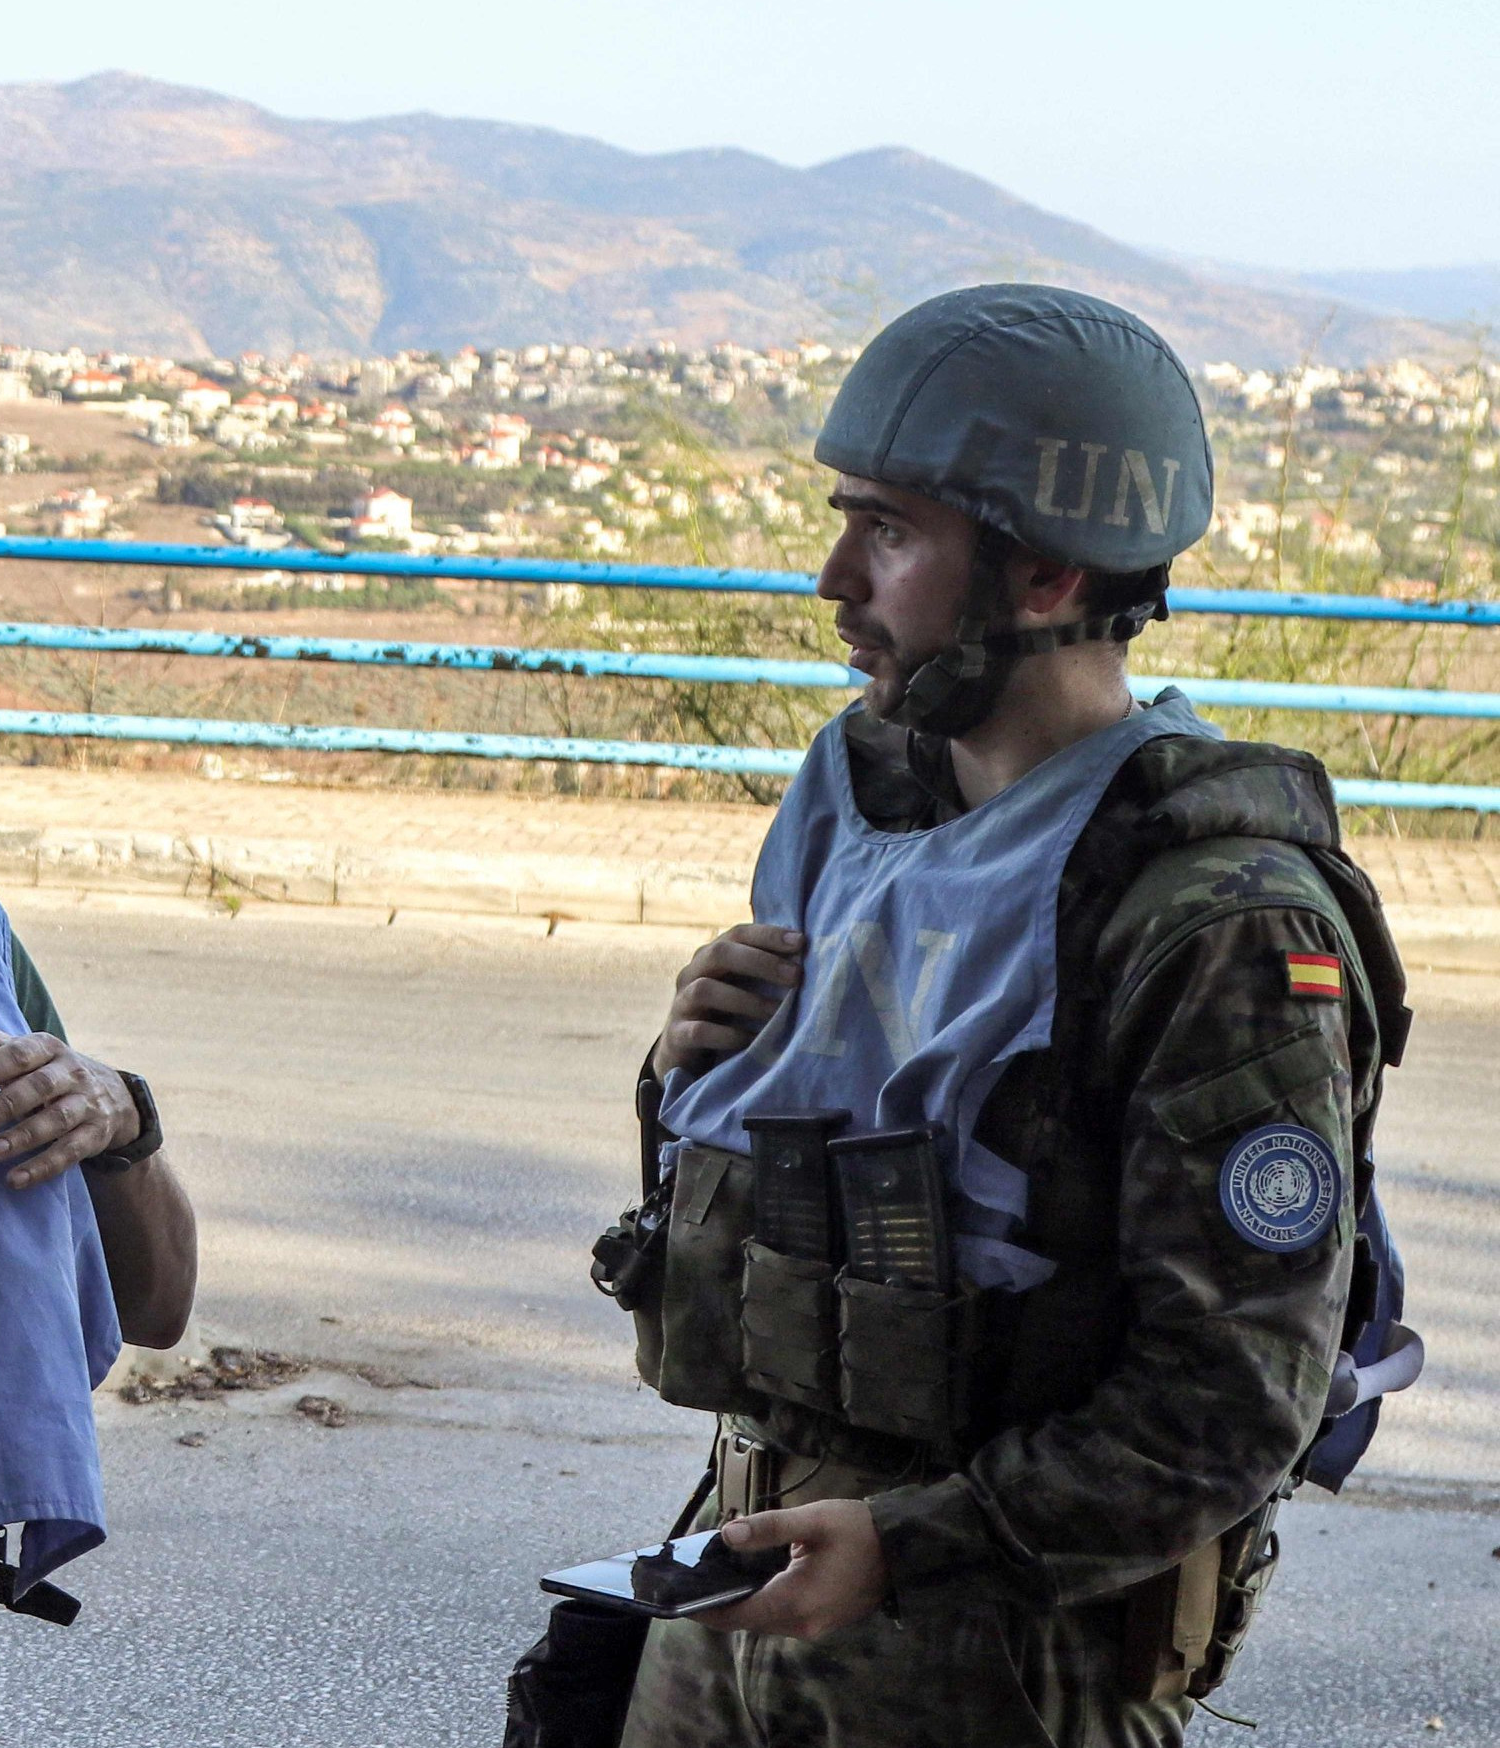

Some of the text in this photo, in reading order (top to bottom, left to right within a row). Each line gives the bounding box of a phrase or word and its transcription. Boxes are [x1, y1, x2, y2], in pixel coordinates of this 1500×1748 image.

[1034, 436, 1181, 536] UN
[746, 920, 959, 1068] N
[1233, 1136, 1326, 1188] UNITED NATIONS
[1240, 1180, 1332, 1240] NATIONS UNIES
